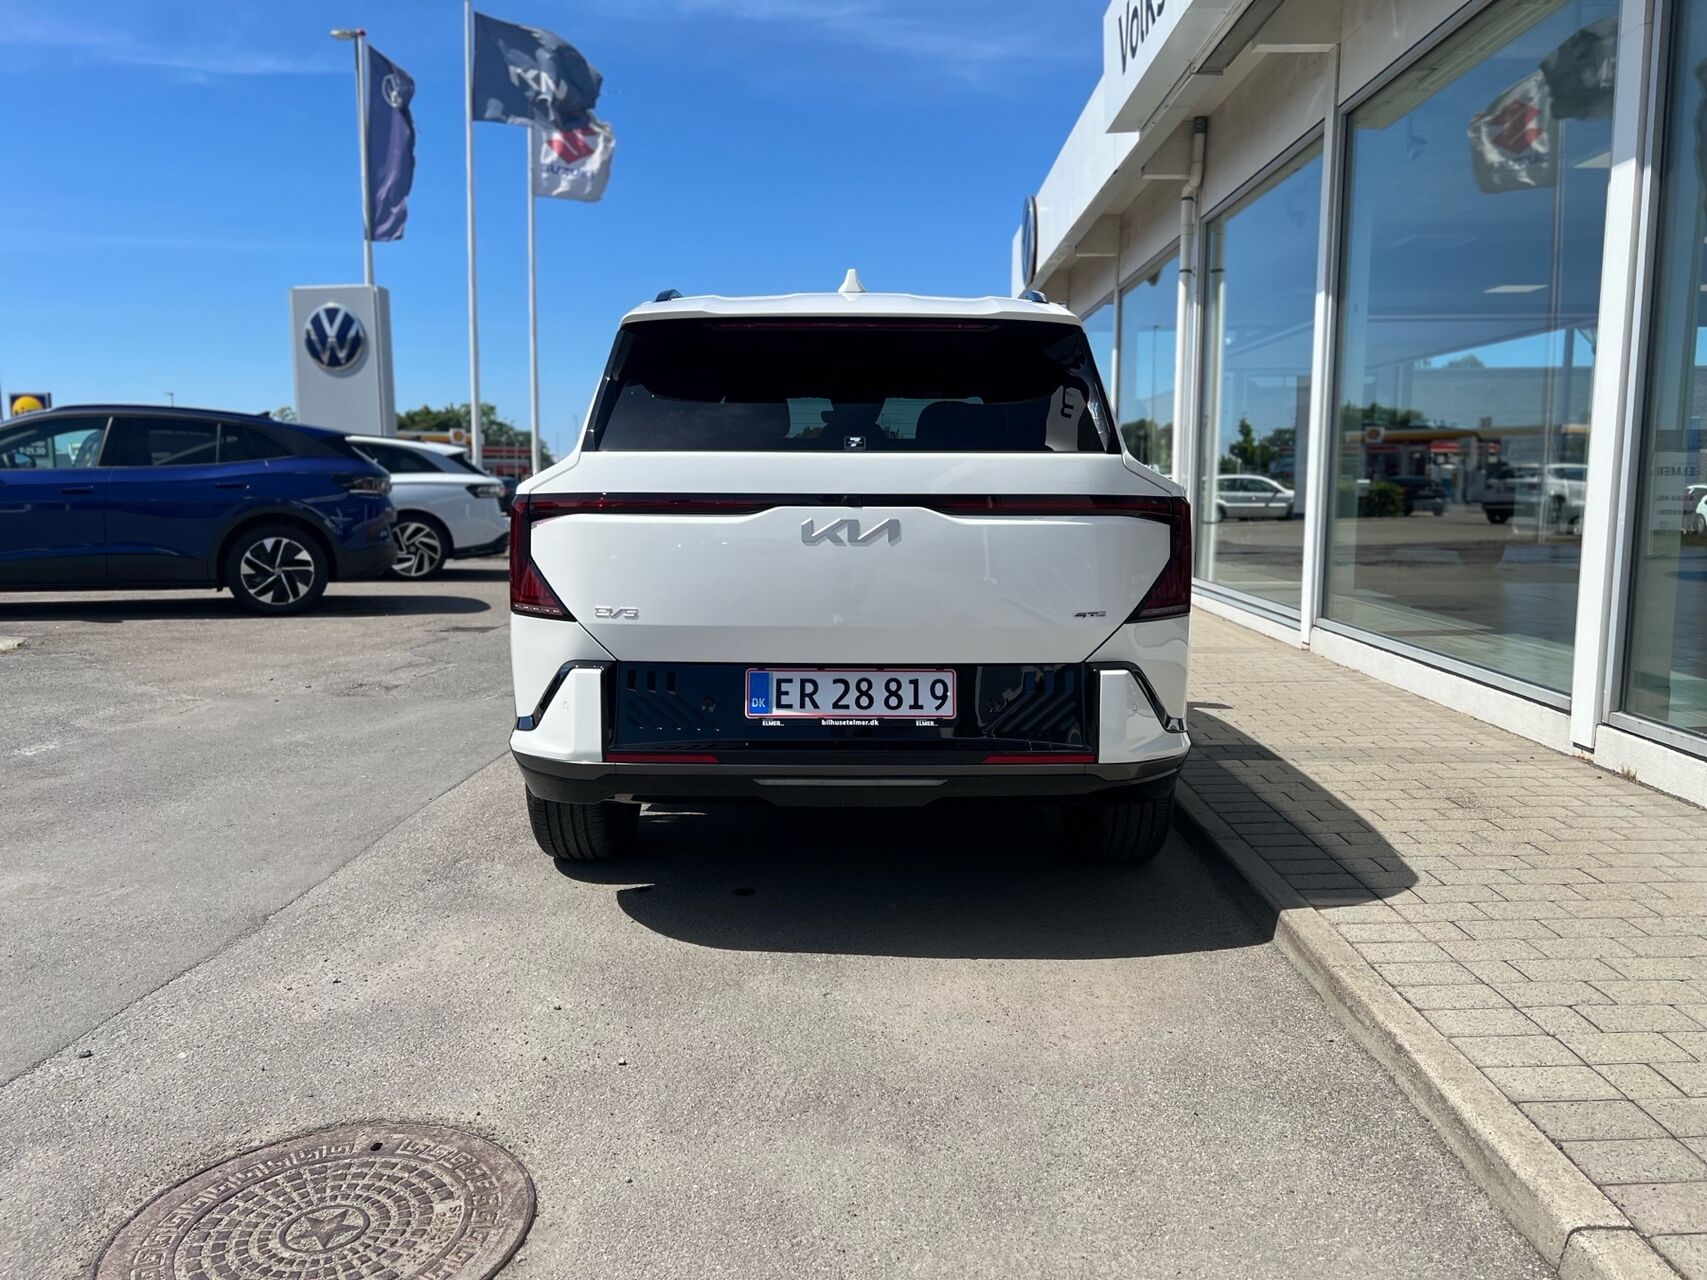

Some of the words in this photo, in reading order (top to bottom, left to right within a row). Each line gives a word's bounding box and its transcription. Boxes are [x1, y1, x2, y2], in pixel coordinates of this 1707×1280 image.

[801, 517, 901, 547] KIA
[751, 697, 766, 708] DK
[775, 678, 820, 710] ER
[831, 677, 875, 710] 28
[883, 677, 949, 711] 819
